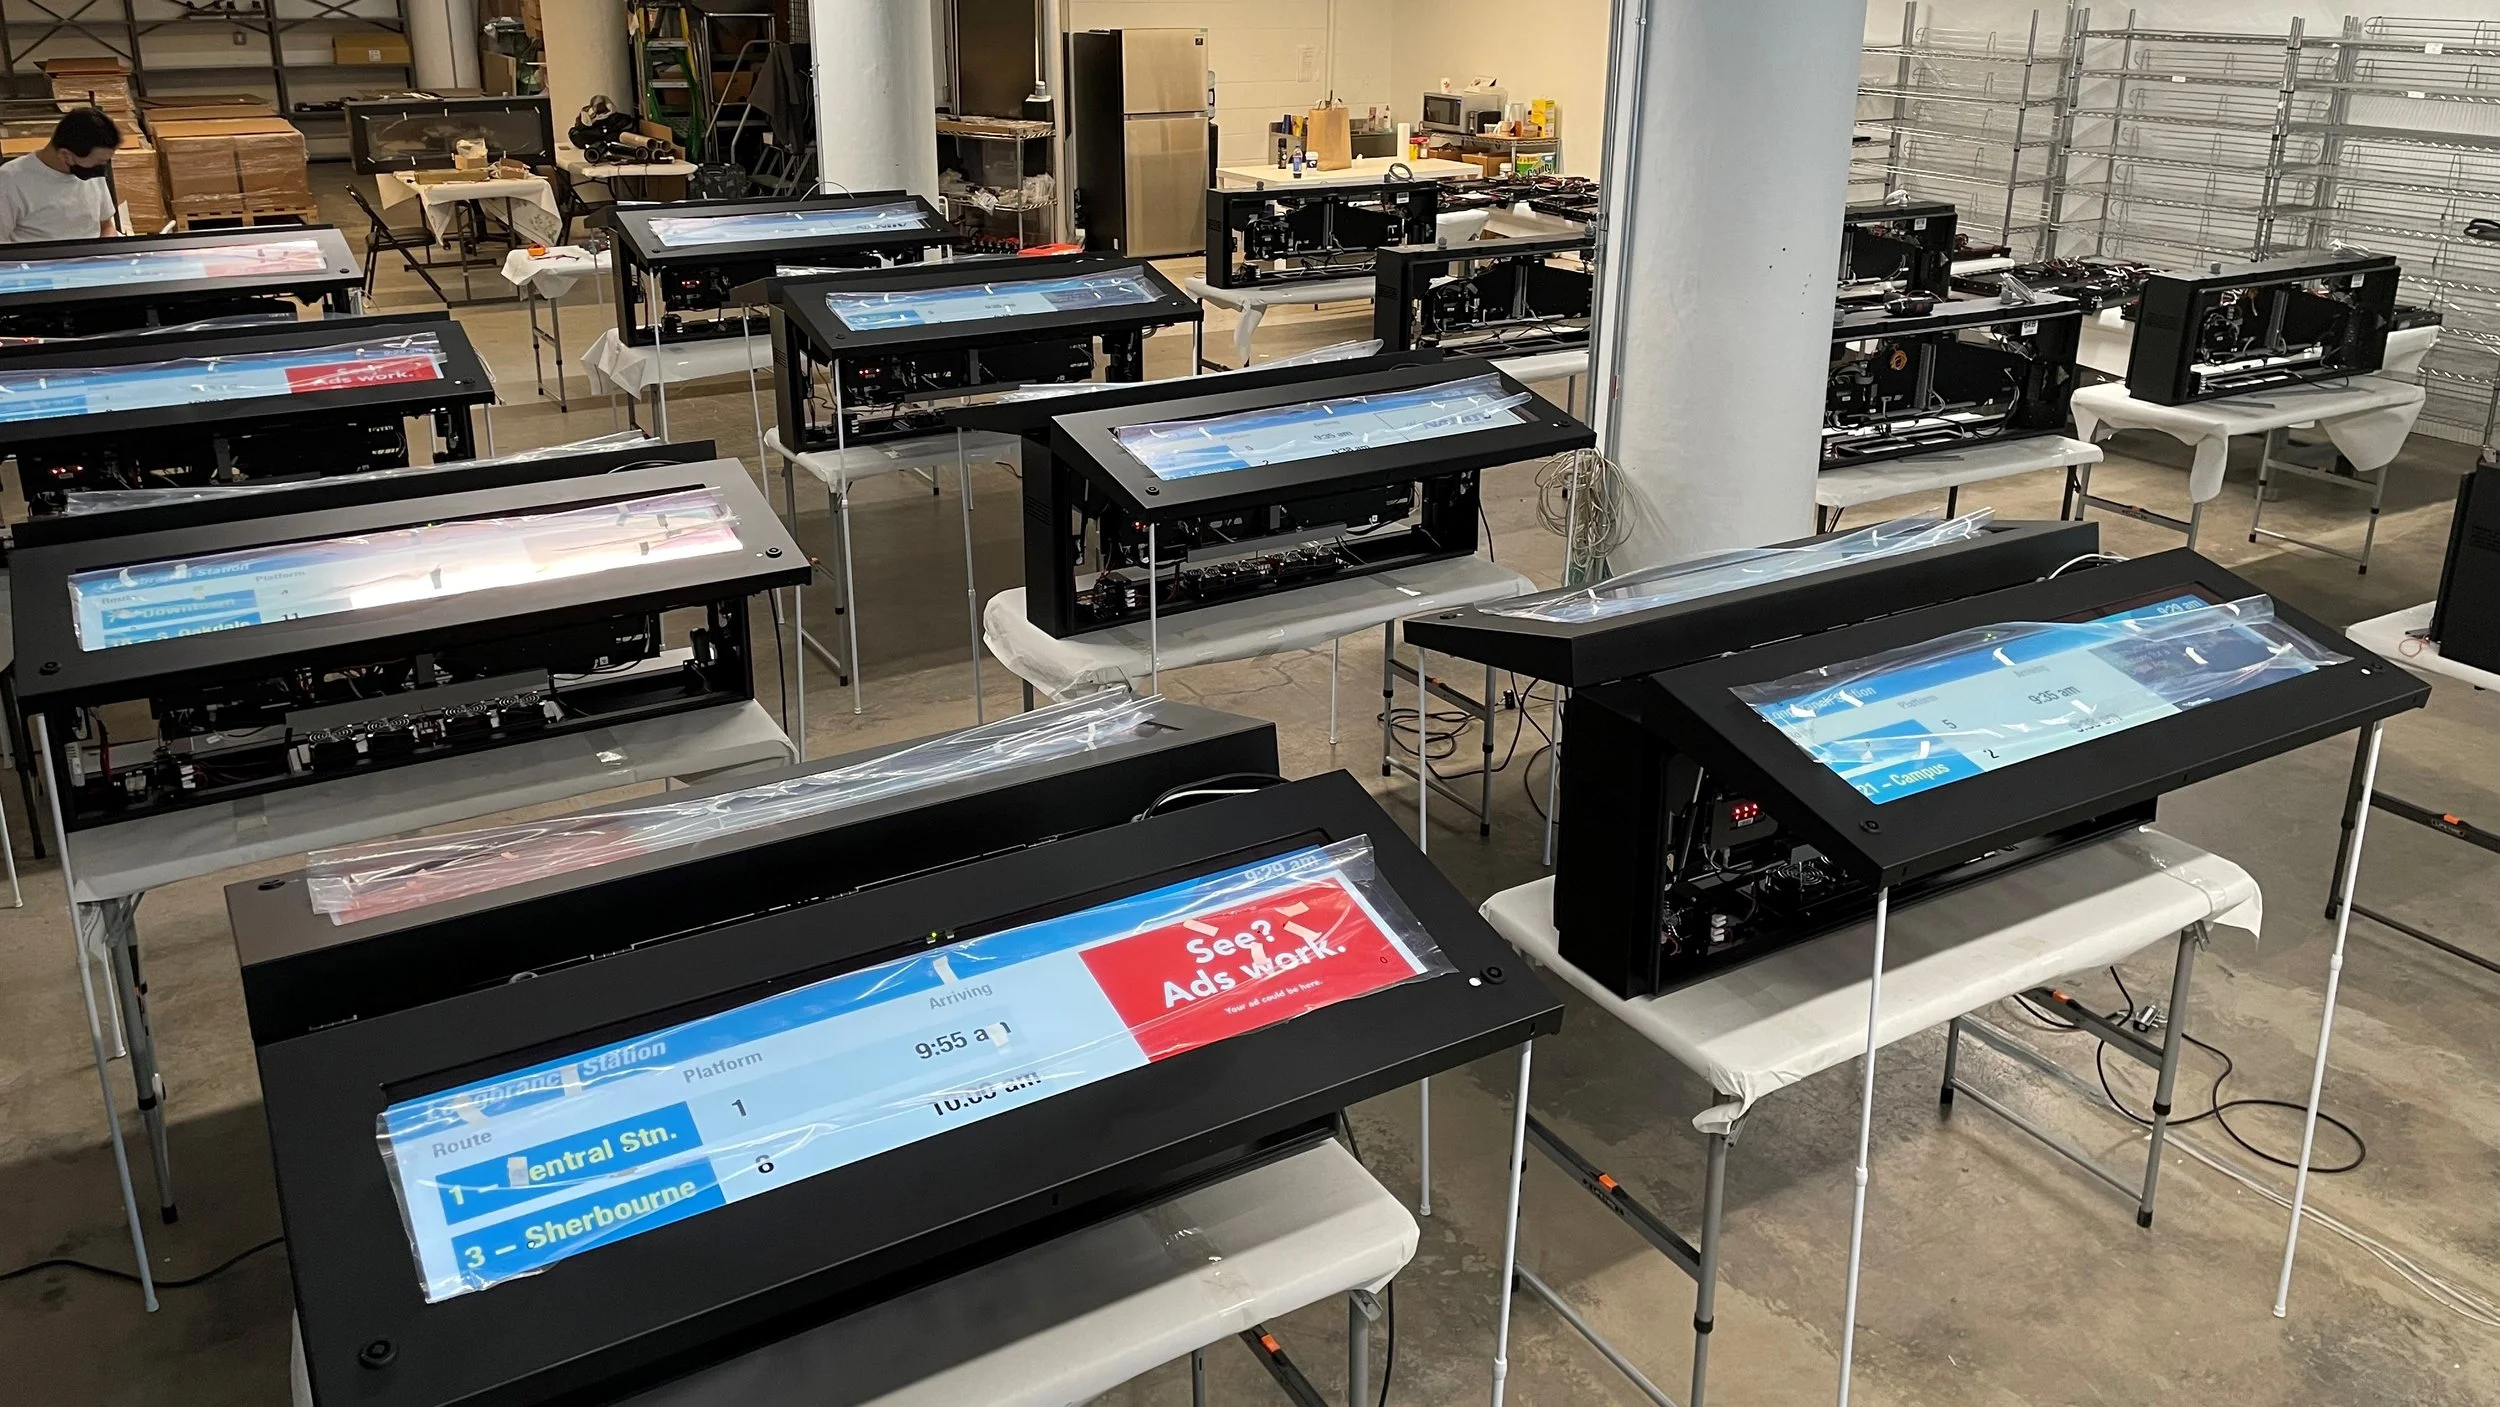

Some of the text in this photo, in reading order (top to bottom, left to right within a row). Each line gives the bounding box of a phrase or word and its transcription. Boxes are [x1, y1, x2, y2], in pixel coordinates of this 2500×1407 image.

[357, 371, 414, 382] work.
[197, 561, 251, 578] Station
[142, 598, 234, 618] Downtown
[2183, 598, 2203, 611] am
[1942, 683, 2082, 730] 5 9:35 am
[1889, 762, 1950, 787] Campus
[1186, 919, 1275, 964] See?
[582, 1041, 667, 1076] Station
[1291, 854, 1320, 871] am
[1163, 938, 1347, 1009] Ads work.
[1224, 979, 1323, 1014] Your ad could be here.
[432, 983, 993, 1159] Route Platform Arriving
[448, 1186, 465, 1206] 1
[511, 1138, 613, 1183] entral
[619, 1125, 678, 1152] Stn.
[731, 1098, 747, 1117] 1
[915, 1031, 968, 1060] 9:55
[464, 1245, 486, 1269] 3
[525, 1180, 696, 1249] Sherbourne
